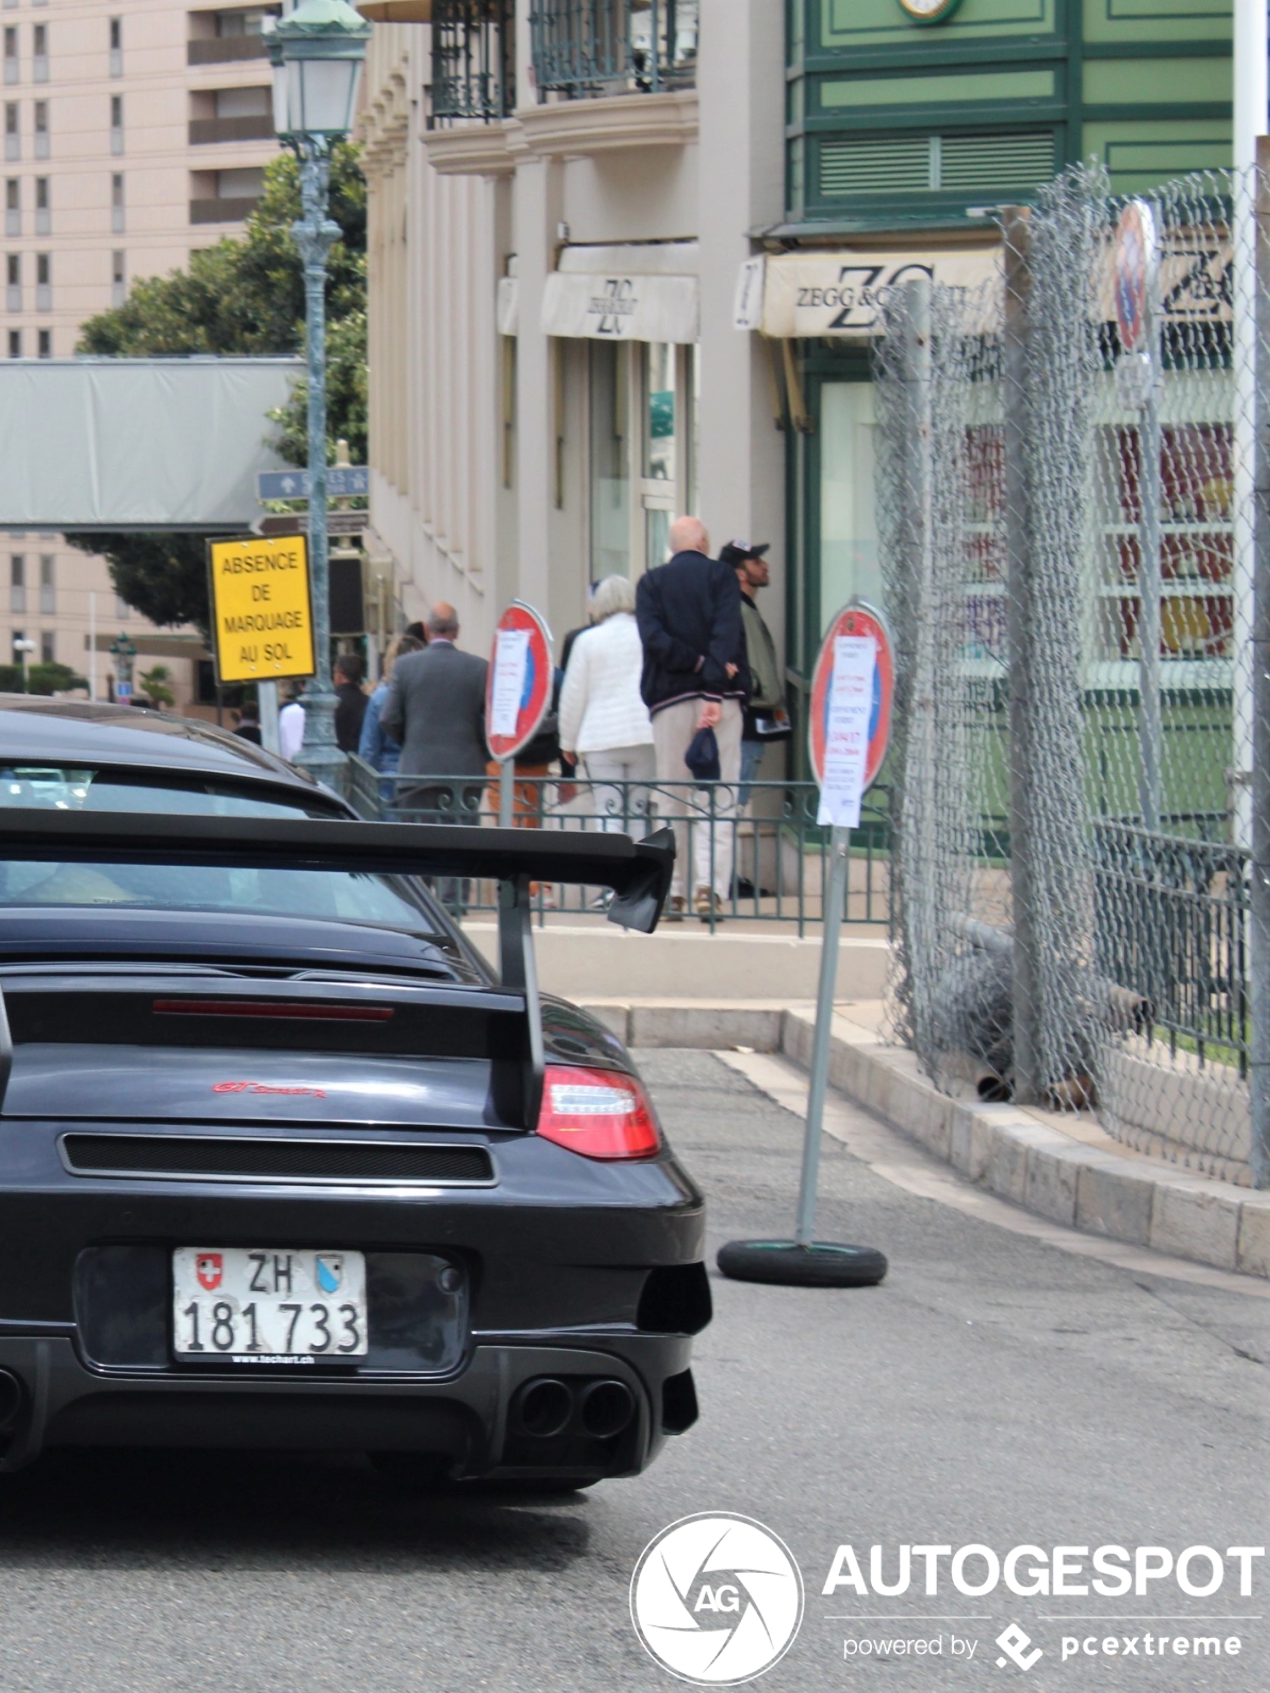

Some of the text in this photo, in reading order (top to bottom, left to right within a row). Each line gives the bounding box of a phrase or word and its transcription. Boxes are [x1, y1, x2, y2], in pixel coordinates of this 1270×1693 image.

[796, 286, 855, 308] ZEGG
[222, 552, 299, 575] ABSENCE
[251, 584, 271, 602] DE
[223, 611, 304, 634] MARQUAGE
[240, 642, 293, 663] AU SOL
[211, 1081, 259, 1094] GT
[248, 1253, 293, 1293] ZH
[232, 1354, 316, 1364] www.techart.ch
